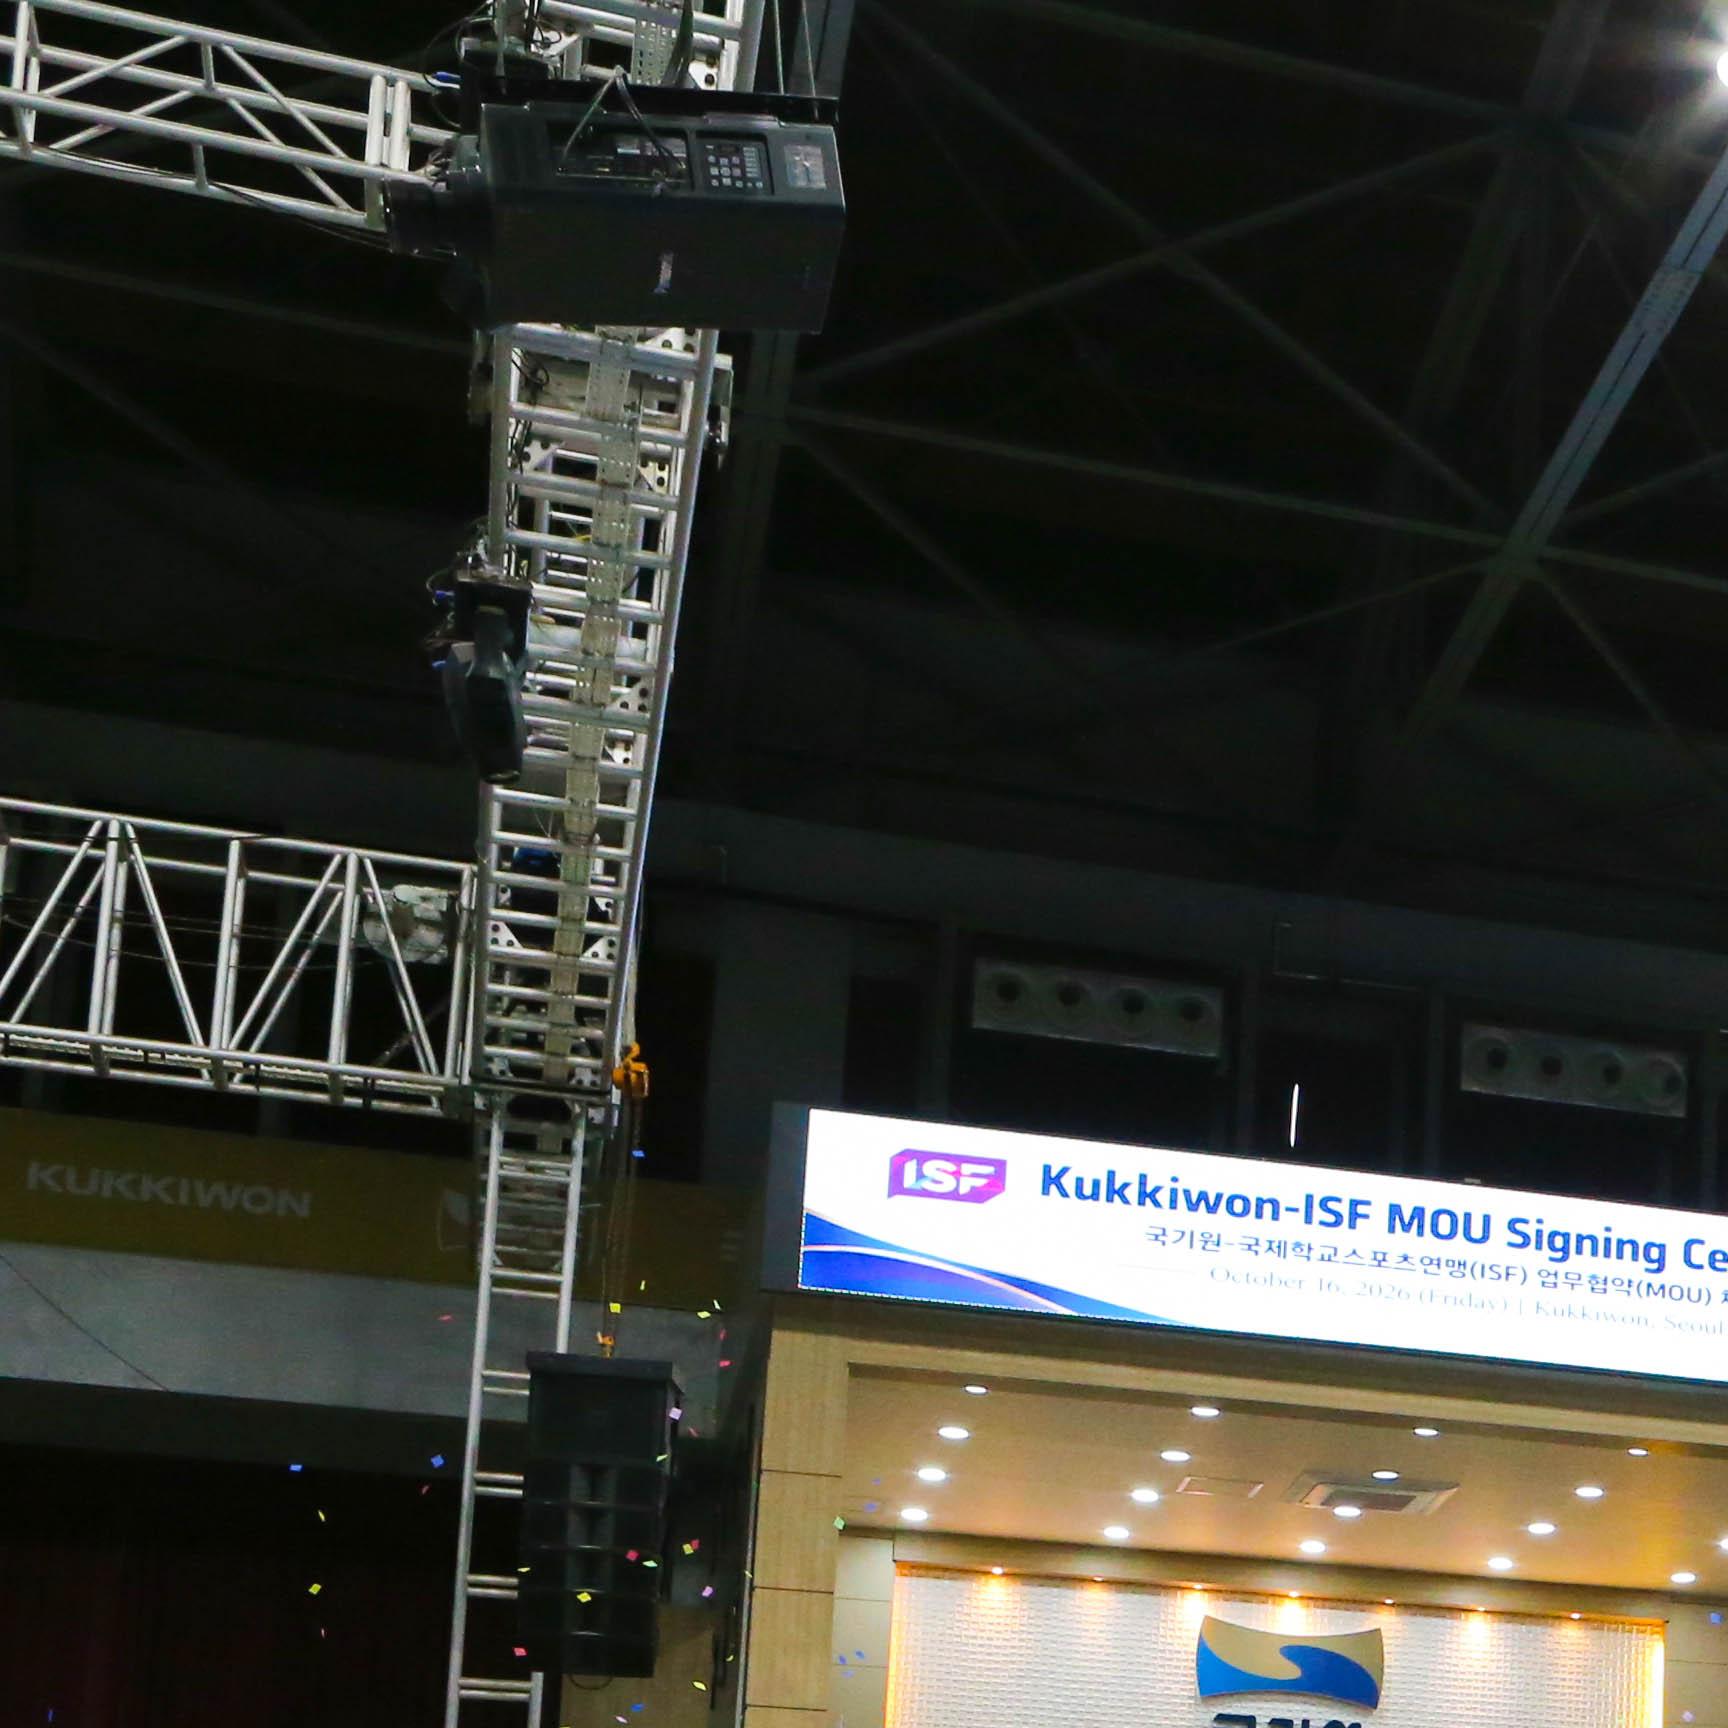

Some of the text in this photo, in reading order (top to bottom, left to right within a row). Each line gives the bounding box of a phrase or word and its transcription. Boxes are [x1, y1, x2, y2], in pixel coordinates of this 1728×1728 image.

[26, 1160, 313, 1218] KUKKIWON
[903, 1158, 996, 1196] ISF
[1041, 1163, 1371, 1231] Kukkiwon-ISF
[1387, 1203, 1491, 1245] MOU
[1506, 1216, 1667, 1275] Signing
[1145, 1224, 1528, 1286] 국기원-국제학교스포츠연맹(ISF)
[1537, 1268, 1712, 1308] 업무협약(MOU)
[1209, 1265, 1305, 1291] October
